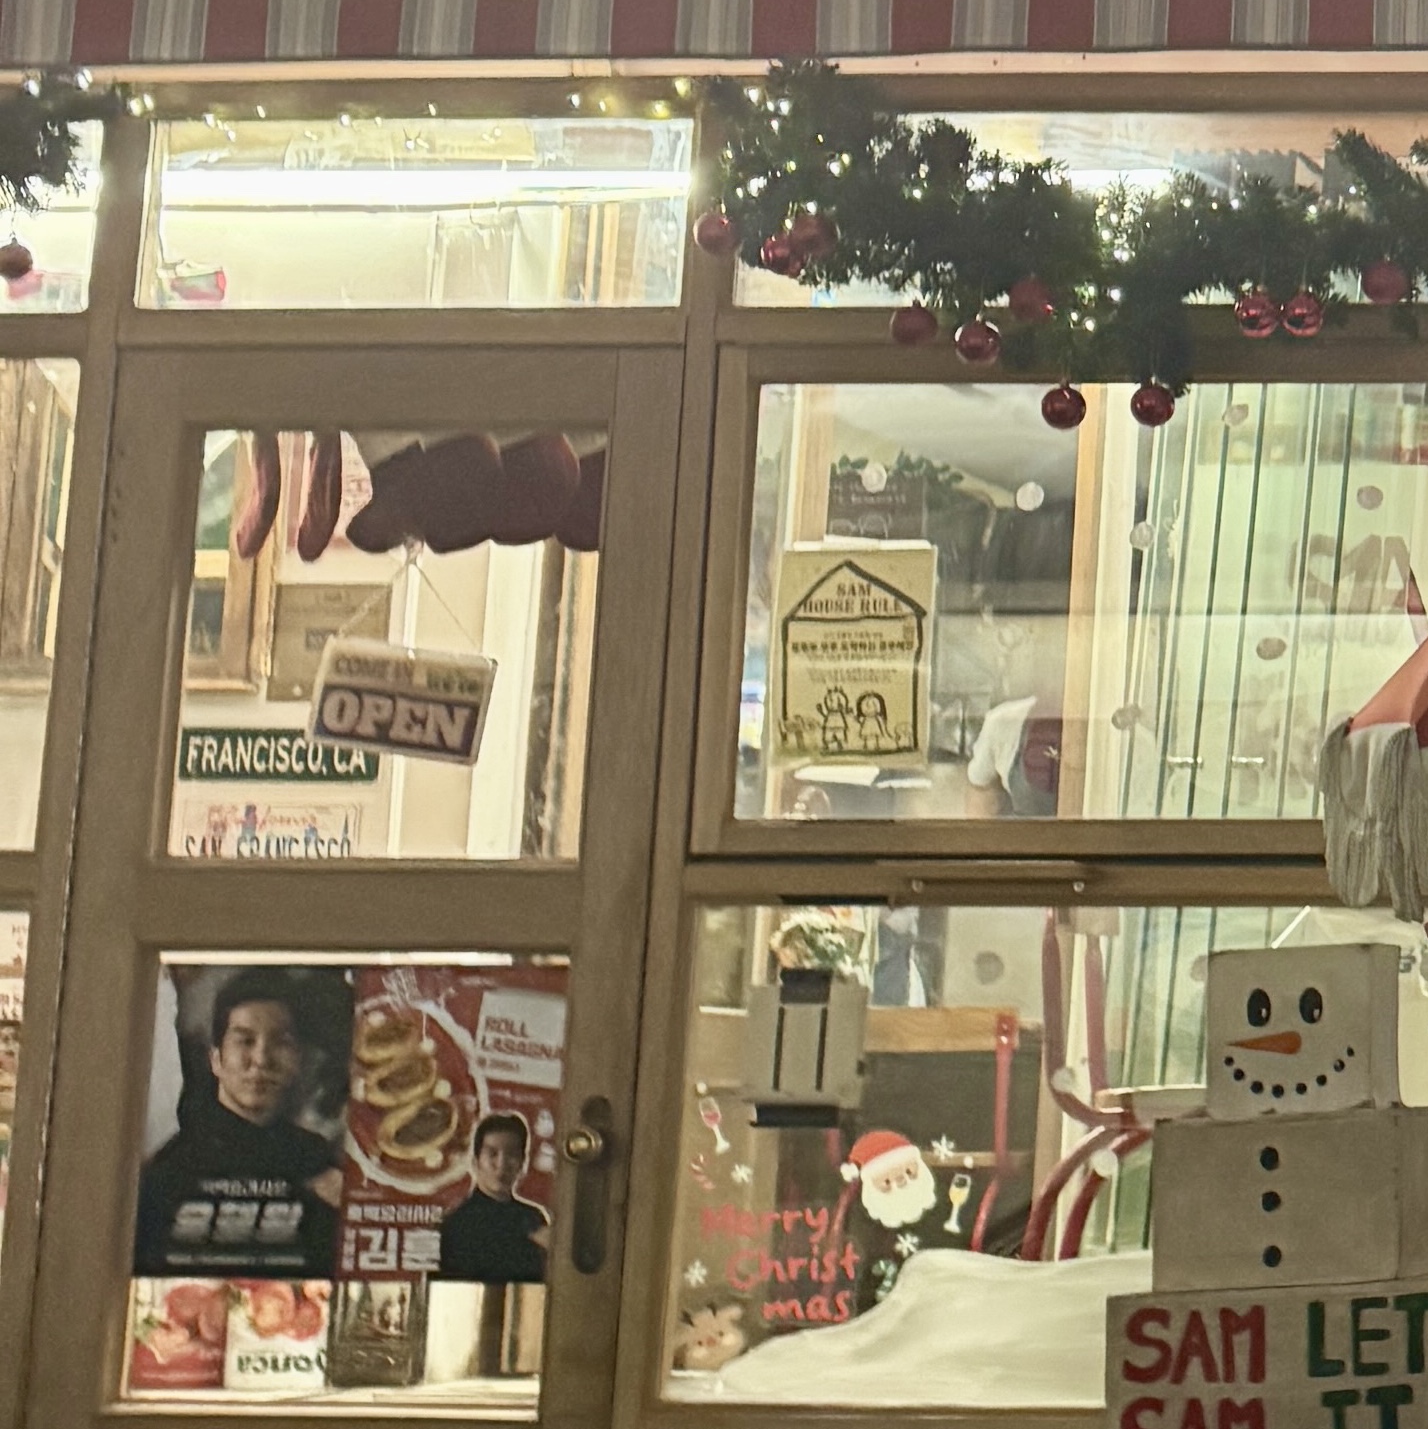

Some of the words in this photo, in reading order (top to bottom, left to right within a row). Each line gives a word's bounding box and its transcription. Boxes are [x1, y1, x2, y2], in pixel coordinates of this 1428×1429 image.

[836, 583, 871, 597] SAM
[322, 688, 472, 750] OPEN
[702, 1205, 829, 1245] Merry
[726, 1242, 860, 1292] Christ
[762, 1290, 852, 1323] mas
[1123, 1305, 1266, 1384] SAM
